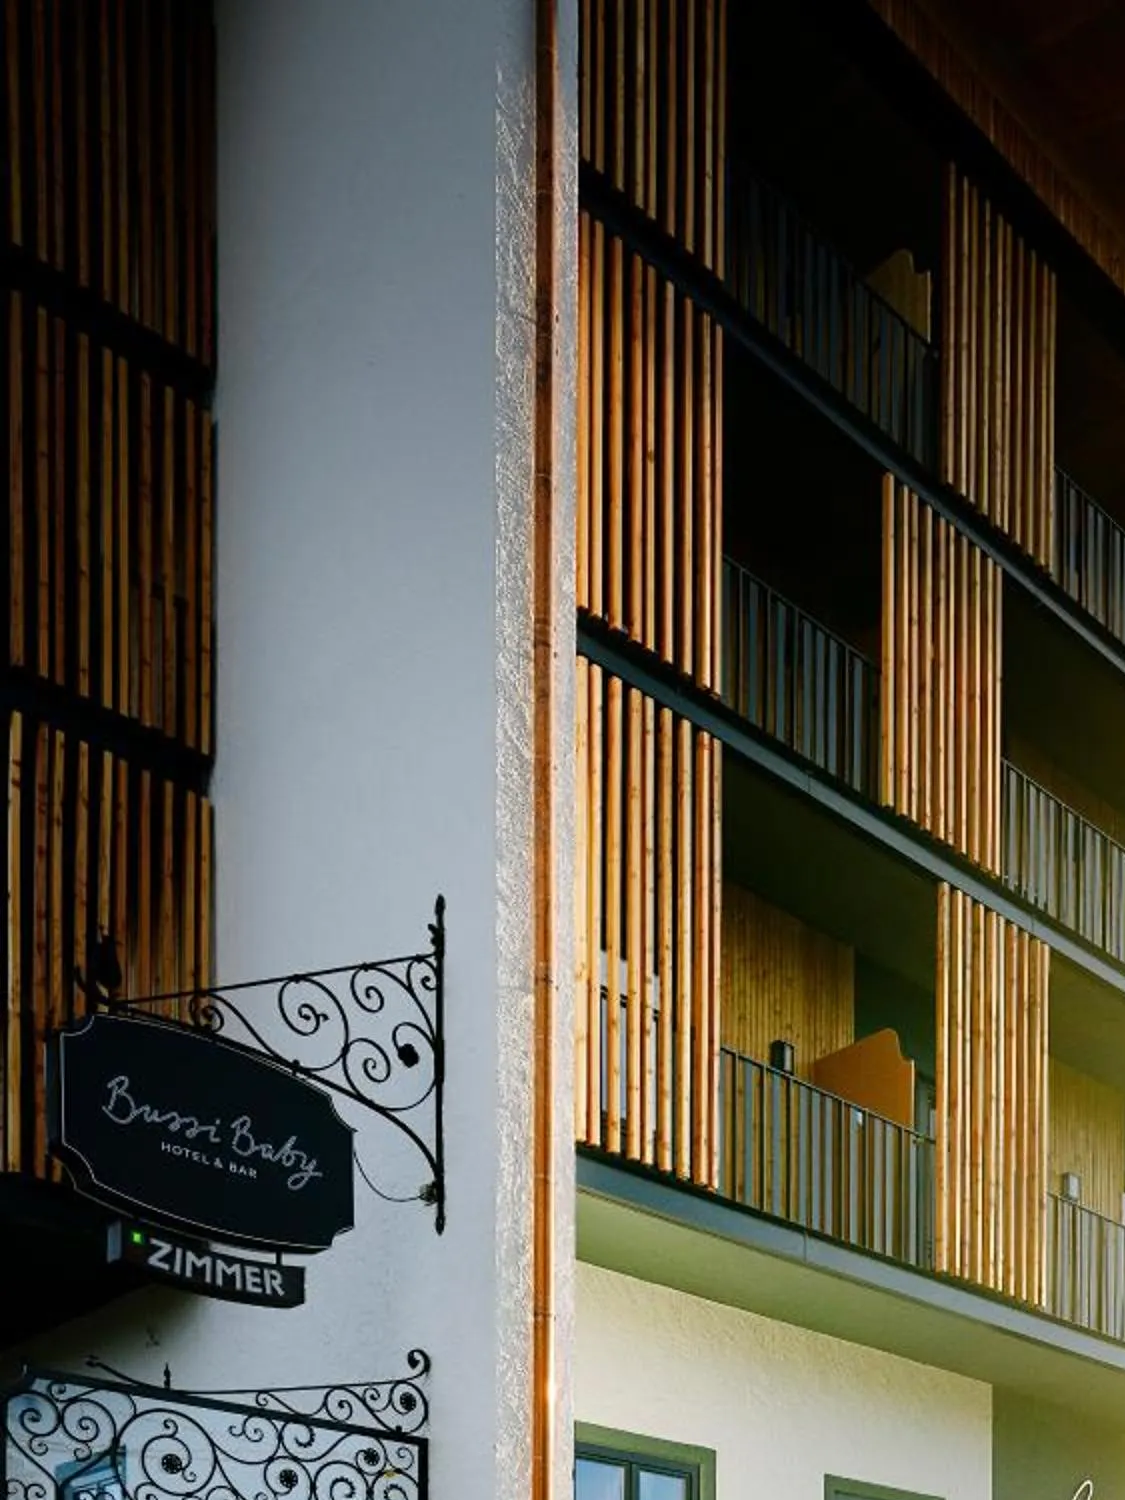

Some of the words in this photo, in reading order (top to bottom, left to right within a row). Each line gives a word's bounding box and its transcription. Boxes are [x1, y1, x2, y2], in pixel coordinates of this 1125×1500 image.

[102, 1075, 221, 1143] Bussi
[230, 1114, 323, 1190] Baby
[160, 1141, 210, 1166] HOTEL
[211, 1156, 224, 1169] &
[229, 1161, 257, 1179] BAR
[148, 1237, 285, 1297] ZIMMER
